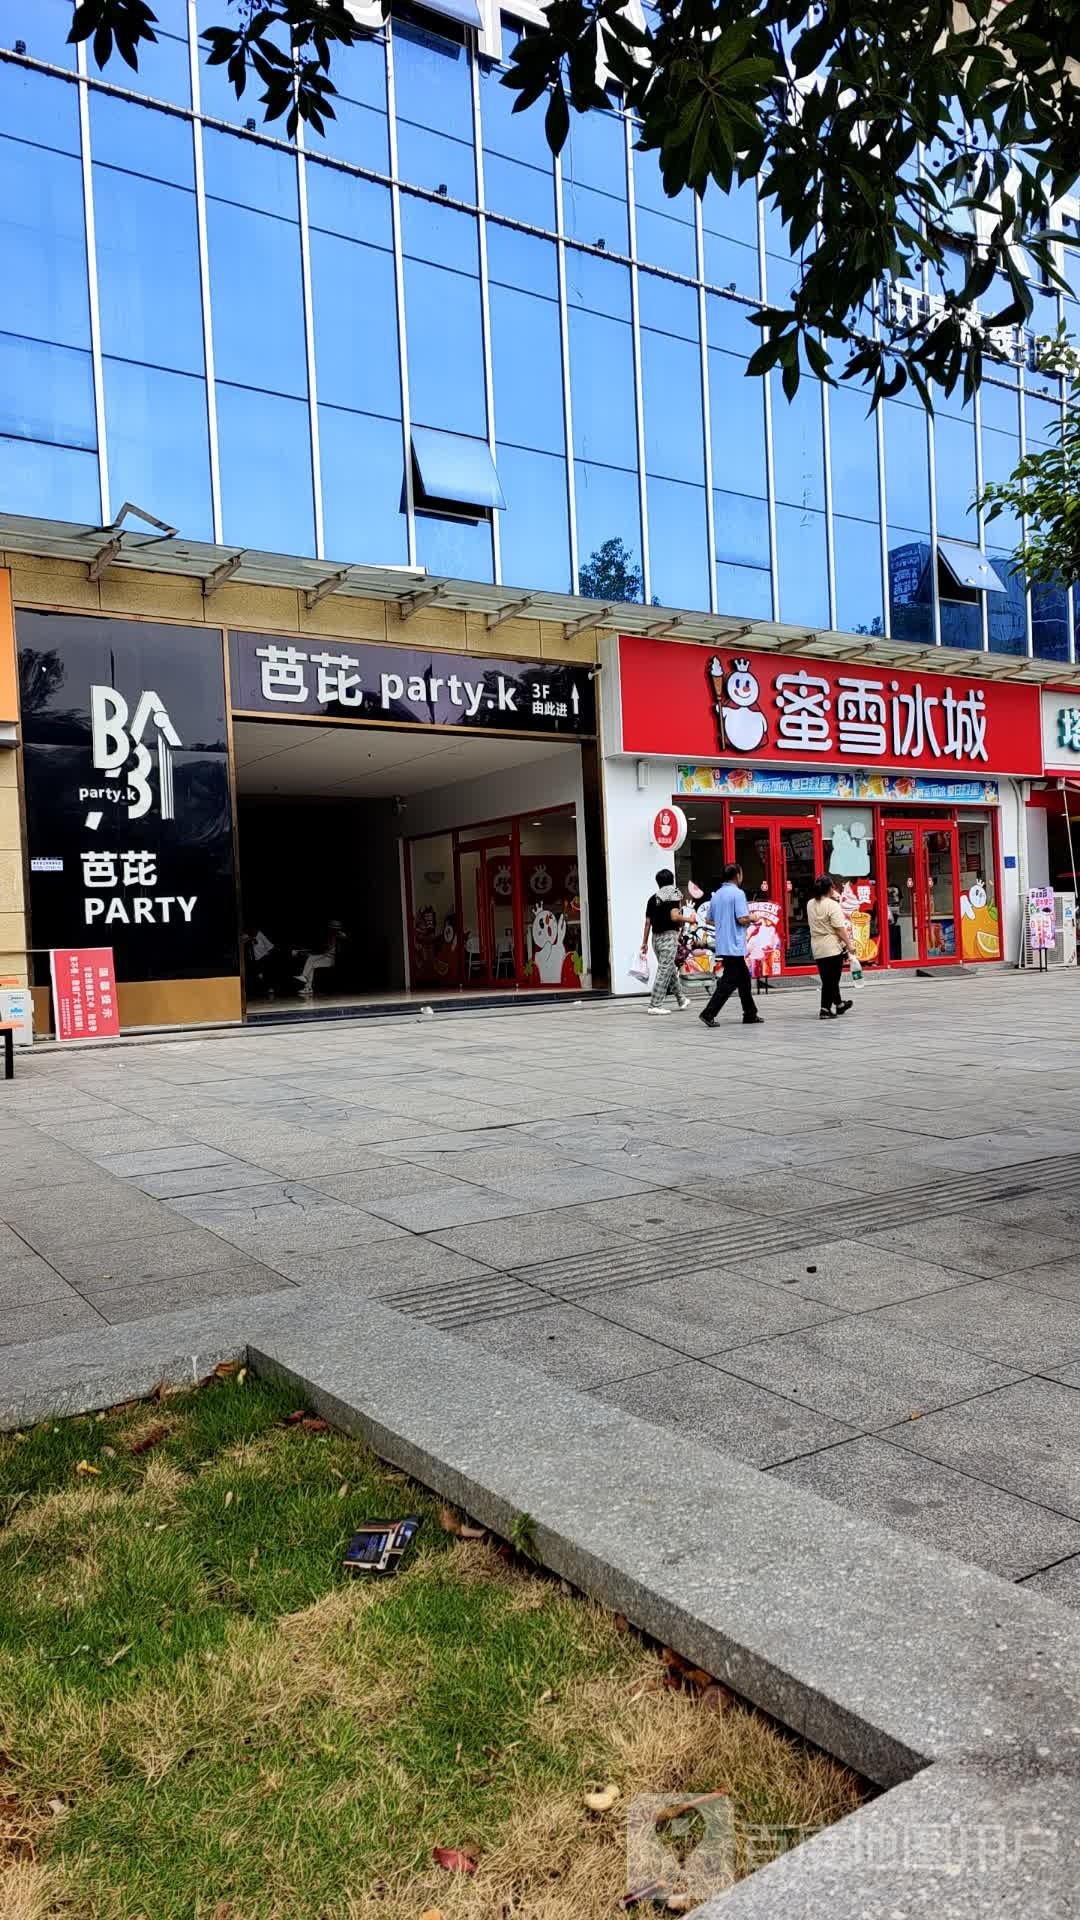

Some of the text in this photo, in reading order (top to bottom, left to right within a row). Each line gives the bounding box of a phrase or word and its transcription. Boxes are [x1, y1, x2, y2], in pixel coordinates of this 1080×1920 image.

[255, 644, 518, 717] 芭芘 party.k
[531, 683, 550, 700] 3F
[532, 702, 568, 718] 由此进
[775, 669, 989, 762] 蜜雪冰城
[78, 787, 137, 804] party.k
[80, 850, 158, 888] 芭芘
[84, 896, 198, 925] PARTY
